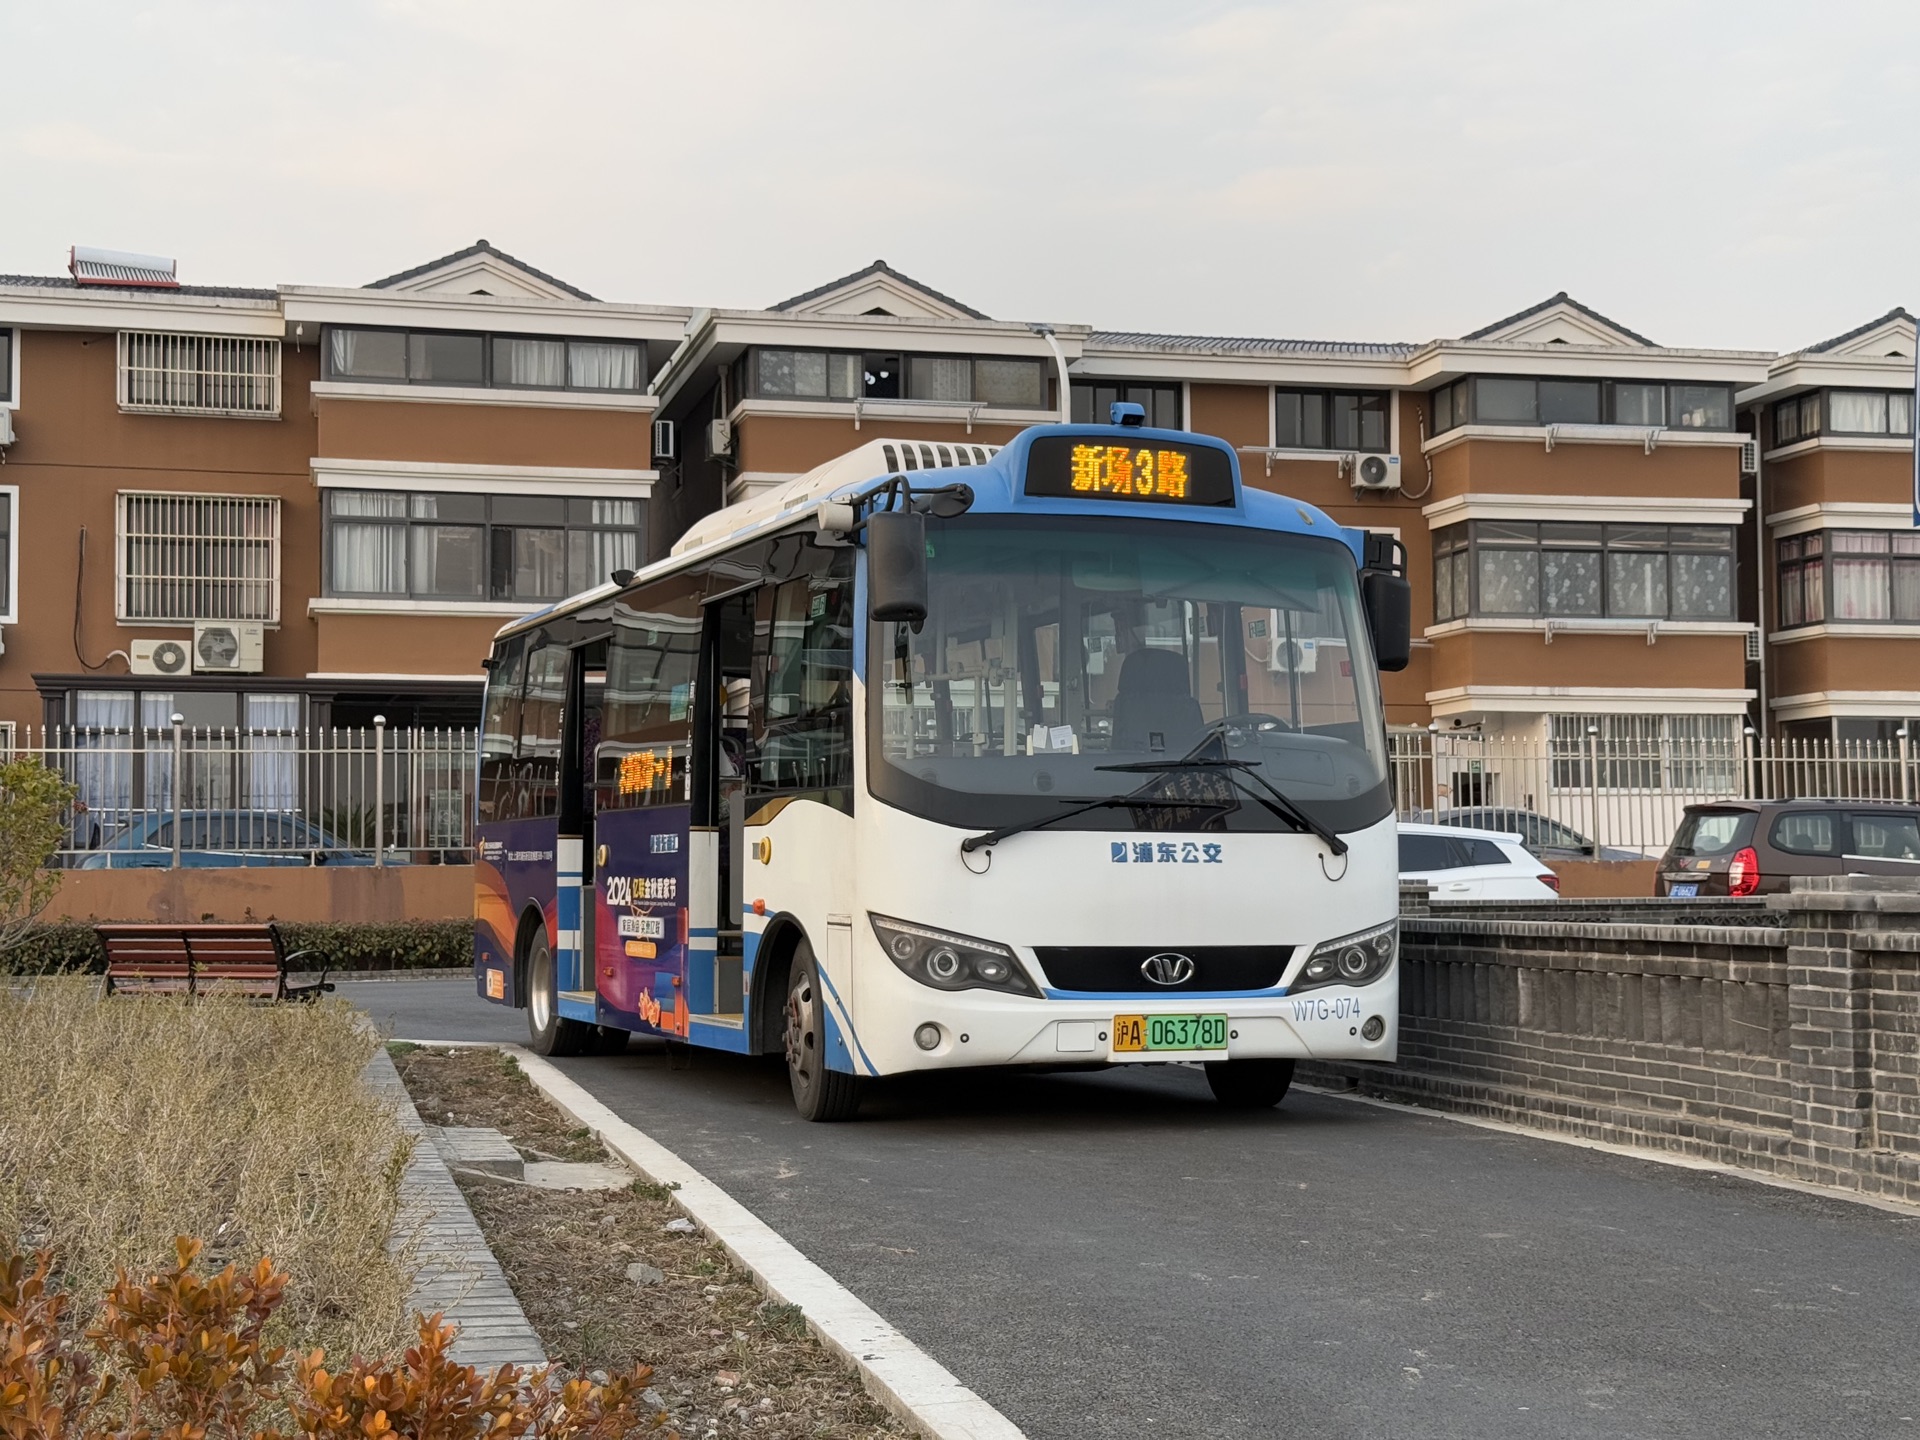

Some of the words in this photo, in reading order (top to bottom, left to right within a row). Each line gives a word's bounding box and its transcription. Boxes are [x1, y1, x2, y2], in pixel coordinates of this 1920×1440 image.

[1070, 443, 1188, 498] 新场3路
[1132, 842, 1223, 863] 浦东公交
[606, 876, 632, 906] 2024
[632, 877, 677, 900] 亿联金秋爱家节
[1291, 997, 1360, 1022] W7G-074
[1116, 1020, 1142, 1046] 沪A
[1151, 1019, 1226, 1045] 06378D
